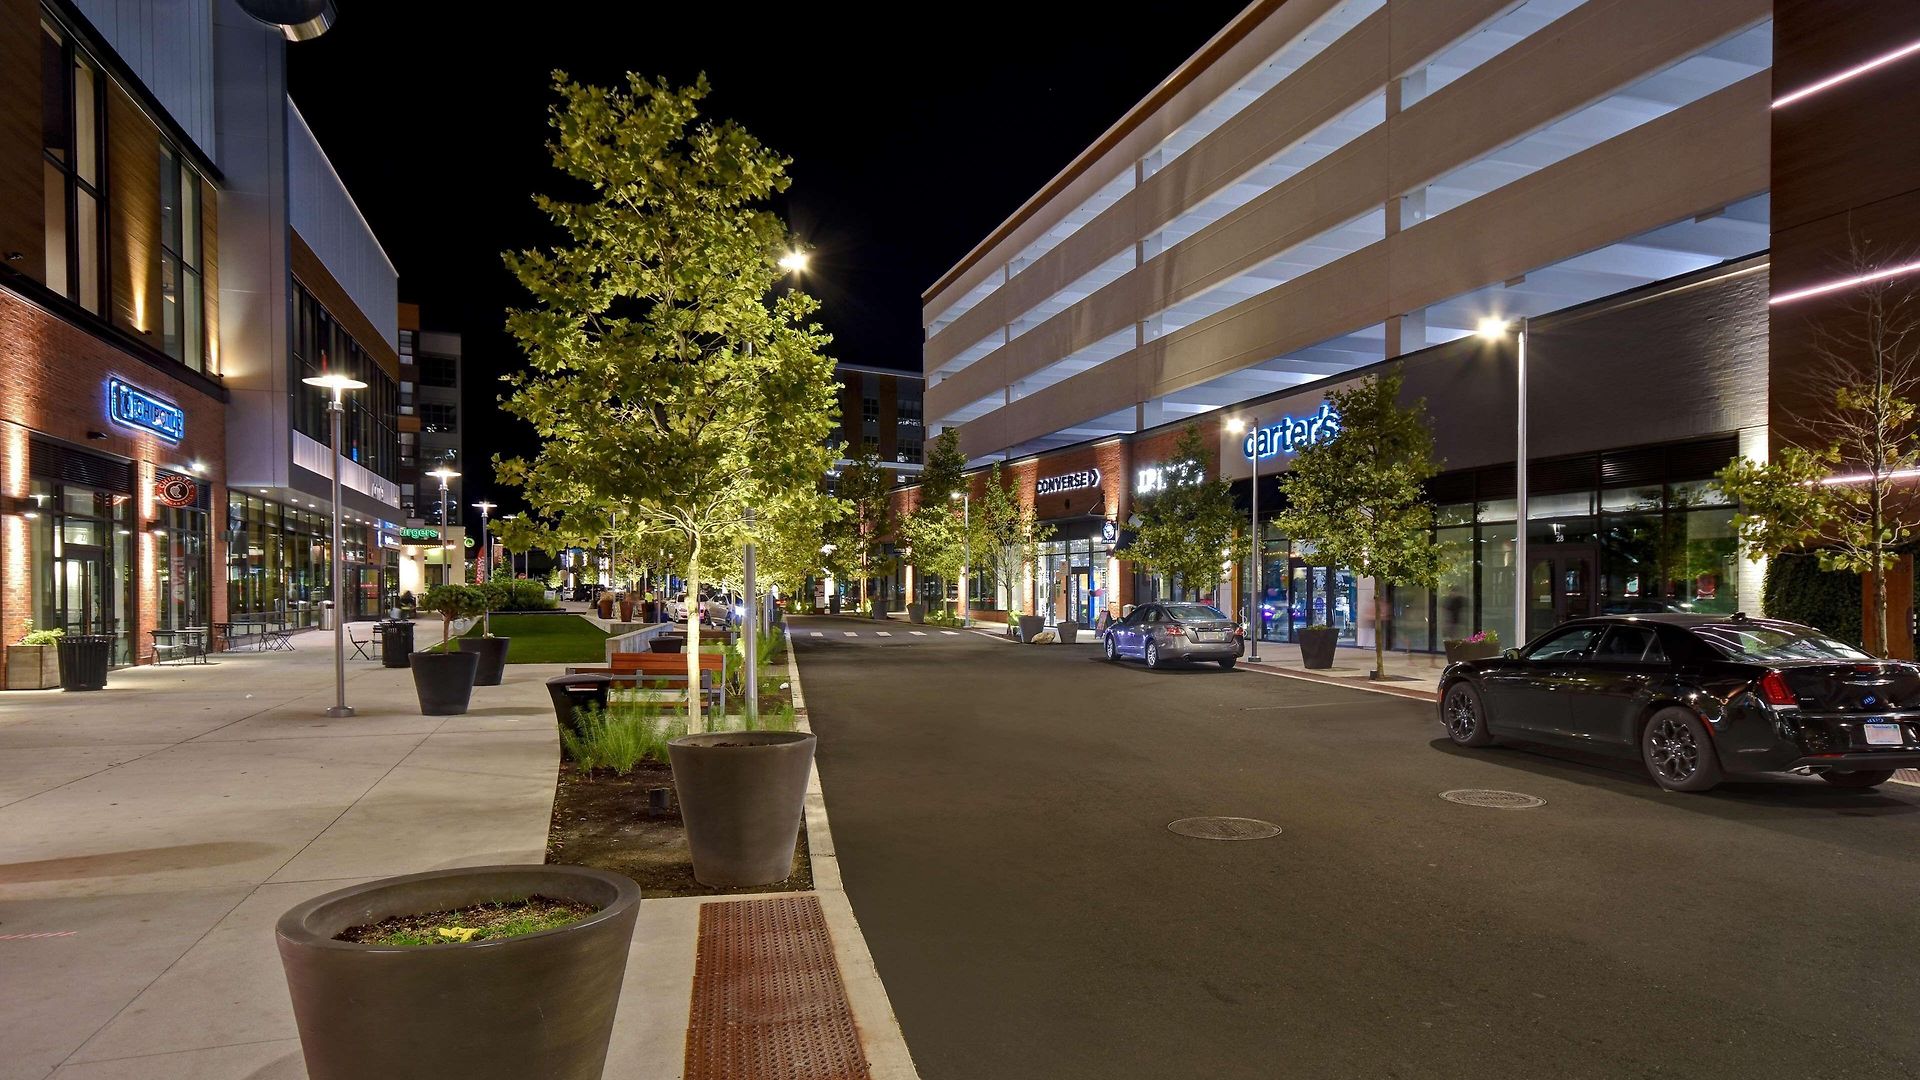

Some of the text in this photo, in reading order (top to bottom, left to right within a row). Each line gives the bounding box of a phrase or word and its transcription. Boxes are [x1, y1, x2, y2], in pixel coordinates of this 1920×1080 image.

[1242, 404, 1340, 460] carter's
[159, 475, 195, 489] CHIPOTLE
[1036, 471, 1088, 494] CONVERSE
[1555, 534, 1564, 542] 28
